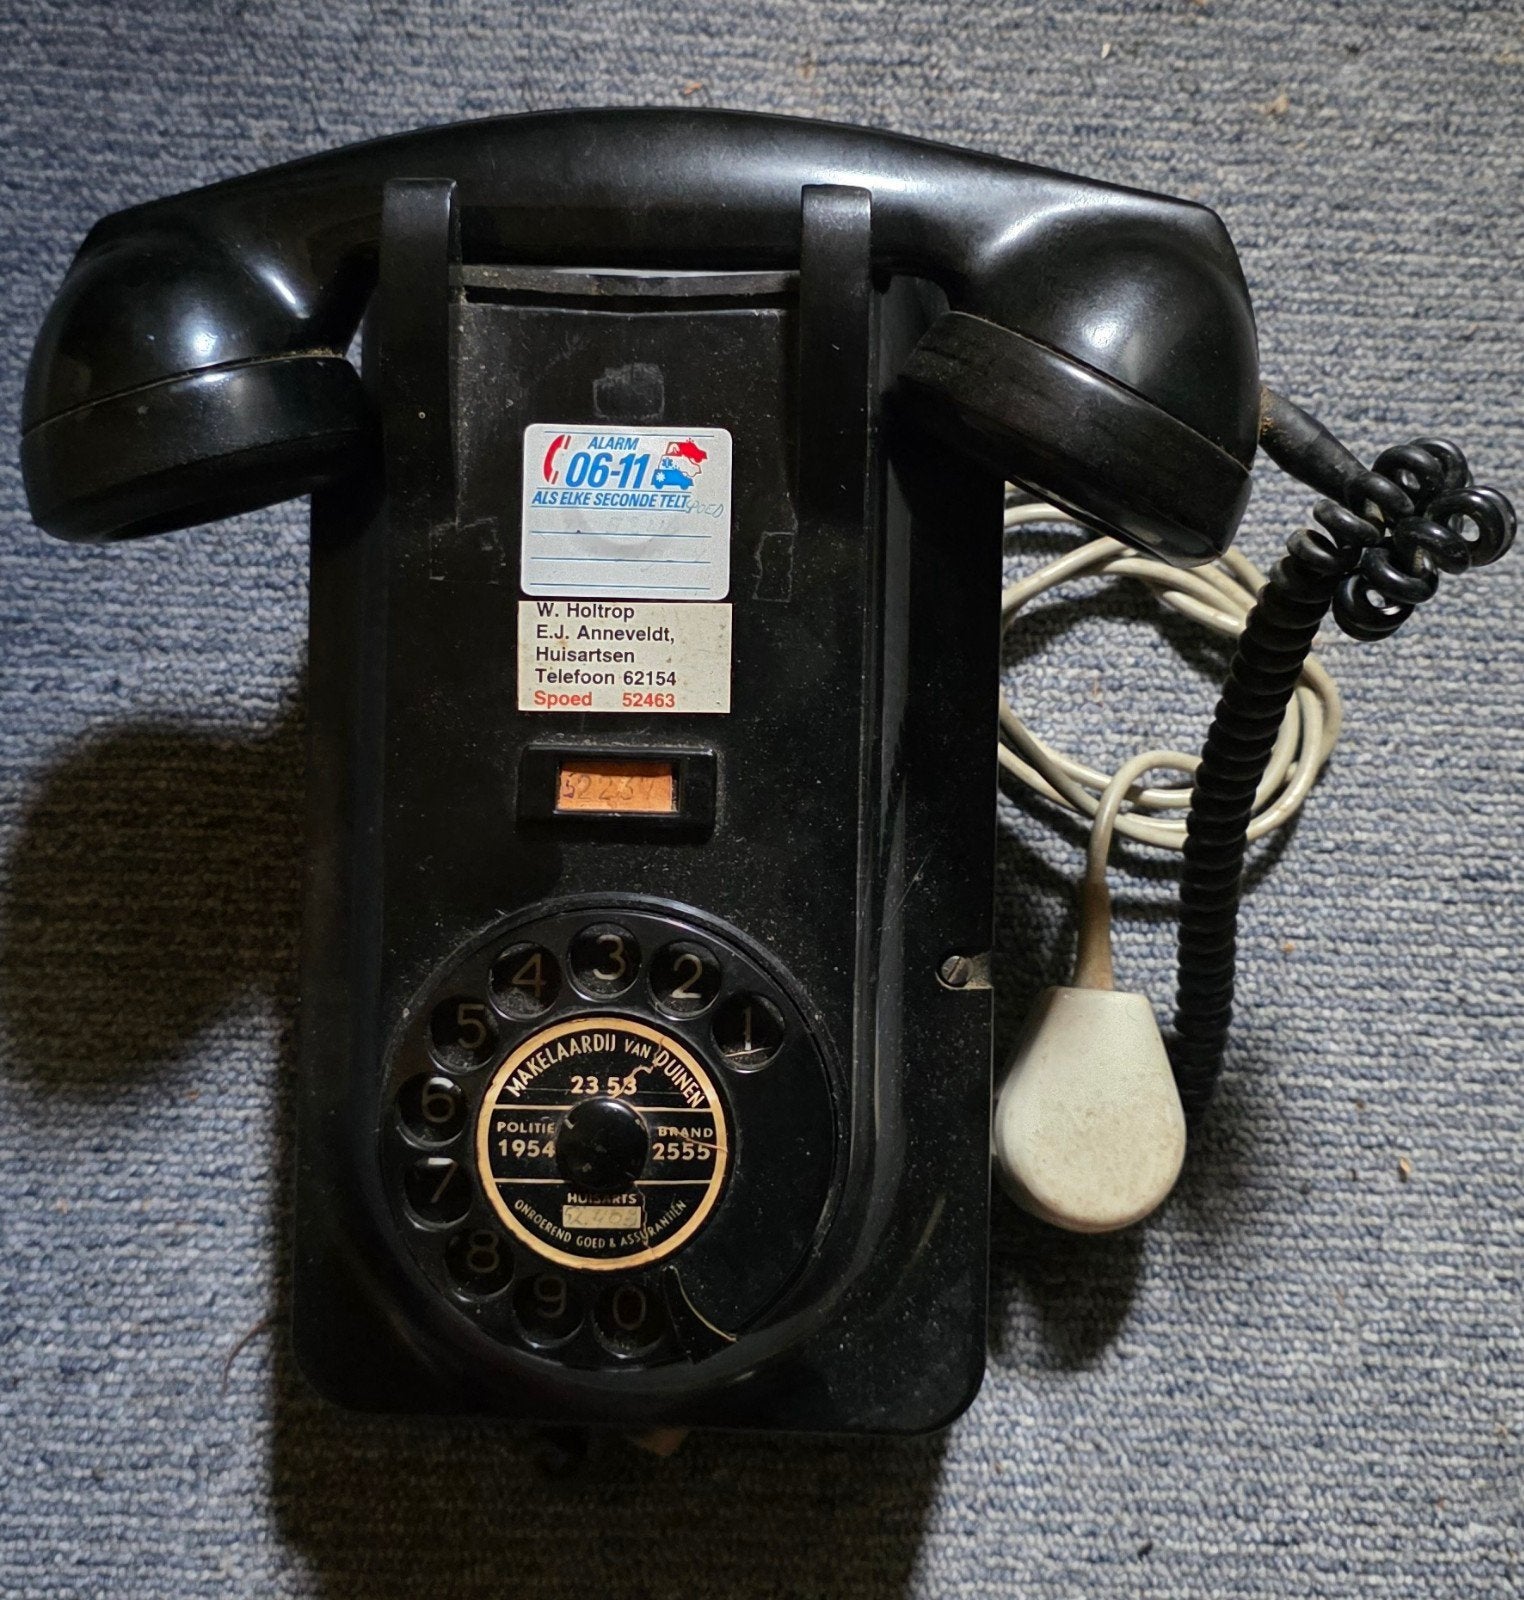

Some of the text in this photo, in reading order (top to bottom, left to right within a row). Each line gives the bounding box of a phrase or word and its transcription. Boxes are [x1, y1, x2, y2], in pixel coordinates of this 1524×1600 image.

[587, 436, 640, 451] ALARM
[565, 451, 651, 489] 06-11
[532, 491, 691, 509] ALS ELKE SECONDE TELT
[536, 602, 635, 623] W. Holtrop
[536, 624, 675, 645] E.J. Anneveldt,
[536, 646, 635, 663] Huisartsen
[535, 668, 677, 686] Telefoon 62154
[533, 690, 676, 709] Spoed 52463
[592, 934, 626, 981] 3
[511, 953, 546, 998] 4
[673, 954, 702, 999] 2
[457, 1003, 486, 1050] 5
[739, 1005, 754, 1051] 1
[504, 1033, 706, 1109] MAKELAARDIJ VAN DUINEN
[571, 1075, 638, 1096] 23 53
[421, 1077, 456, 1123] 6
[497, 1121, 556, 1134] POLITIE
[658, 1126, 714, 1138] BRAND
[498, 1139, 556, 1159] 1954
[652, 1142, 711, 1161] 2555
[422, 1157, 459, 1203] 7
[567, 1192, 638, 1205] HUISARTS
[514, 1199, 572, 1243] ONROEREND
[576, 1235, 606, 1249] GOED
[609, 1235, 616, 1248] &
[466, 1229, 500, 1273] 8
[533, 1274, 568, 1319] 9
